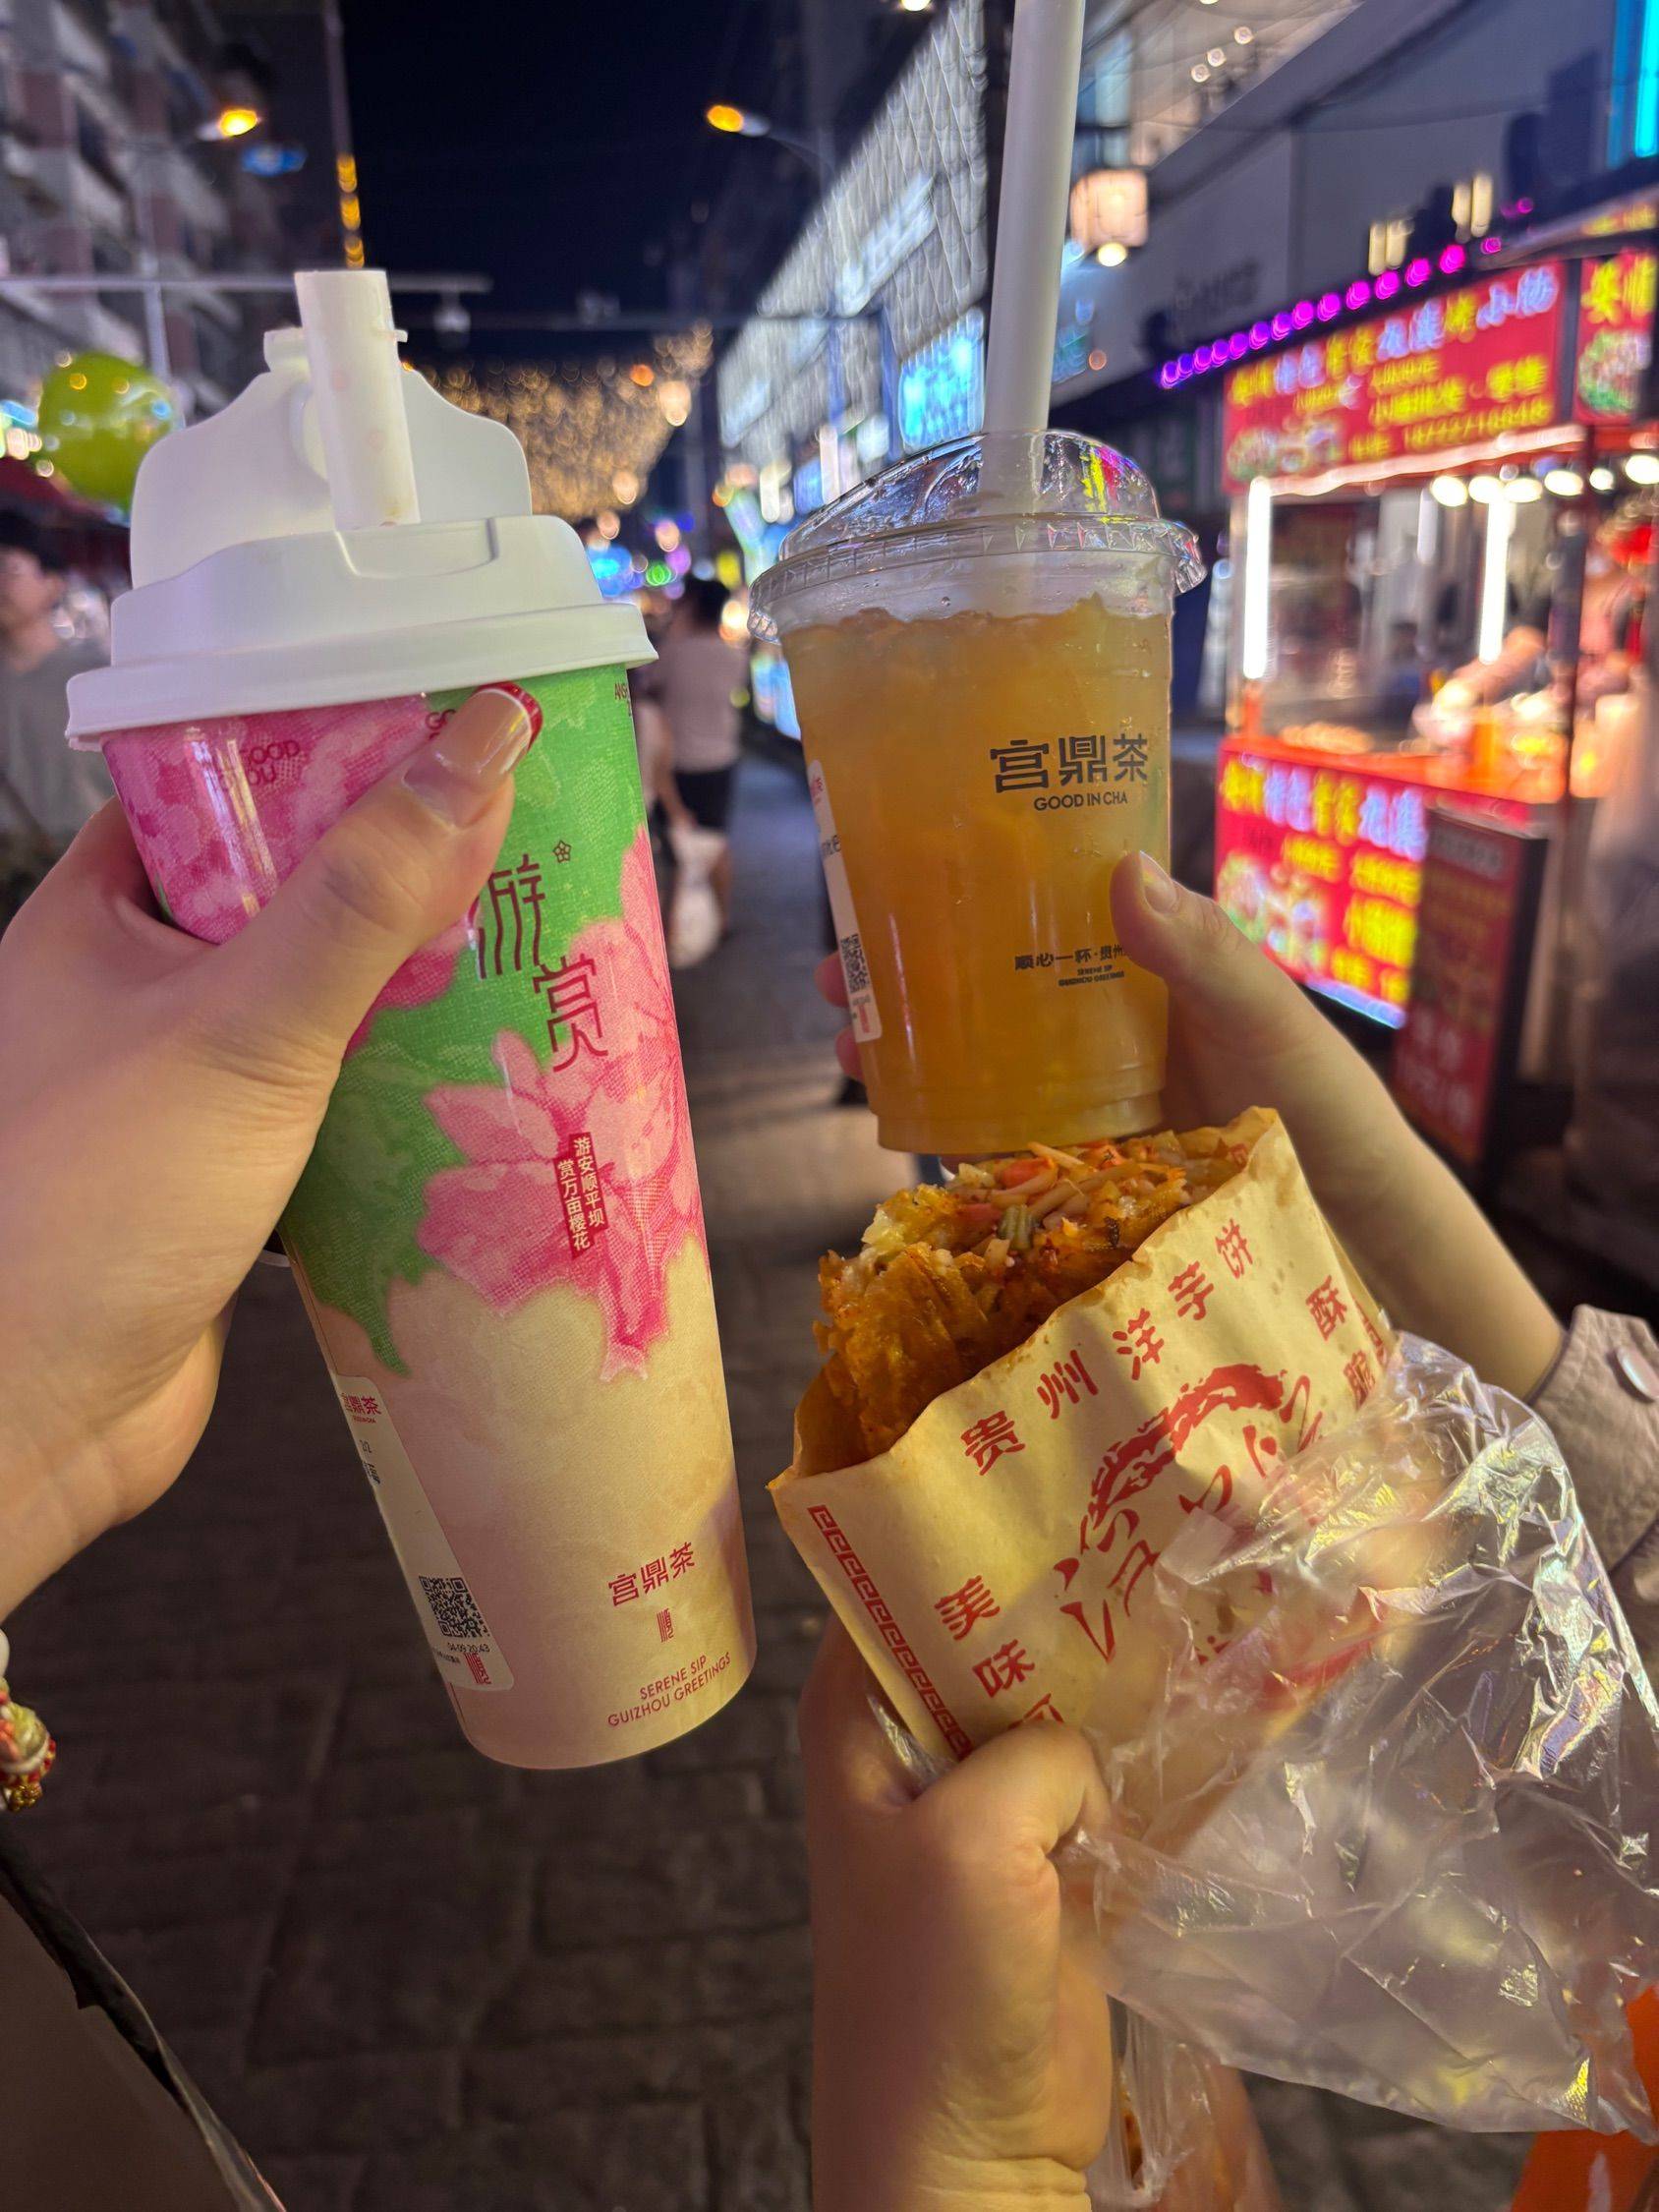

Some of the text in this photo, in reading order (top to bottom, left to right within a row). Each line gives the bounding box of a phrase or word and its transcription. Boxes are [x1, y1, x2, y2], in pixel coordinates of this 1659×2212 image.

[990, 733, 1149, 793] 宫鼎茶
[1034, 790, 1128, 811] GOOD IN CHA
[478, 853, 608, 1073] 游赏
[557, 1159, 591, 1252] 赏万亩樱花
[574, 1136, 604, 1228] 游安顺平坝
[959, 1218, 1253, 1475] 贵州洋芋饼
[608, 1542, 695, 1606] 宫鼎茶
[607, 1652, 731, 1726] GUIZHOU GREETINGS
[640, 1655, 707, 1700] SERENE SIP
